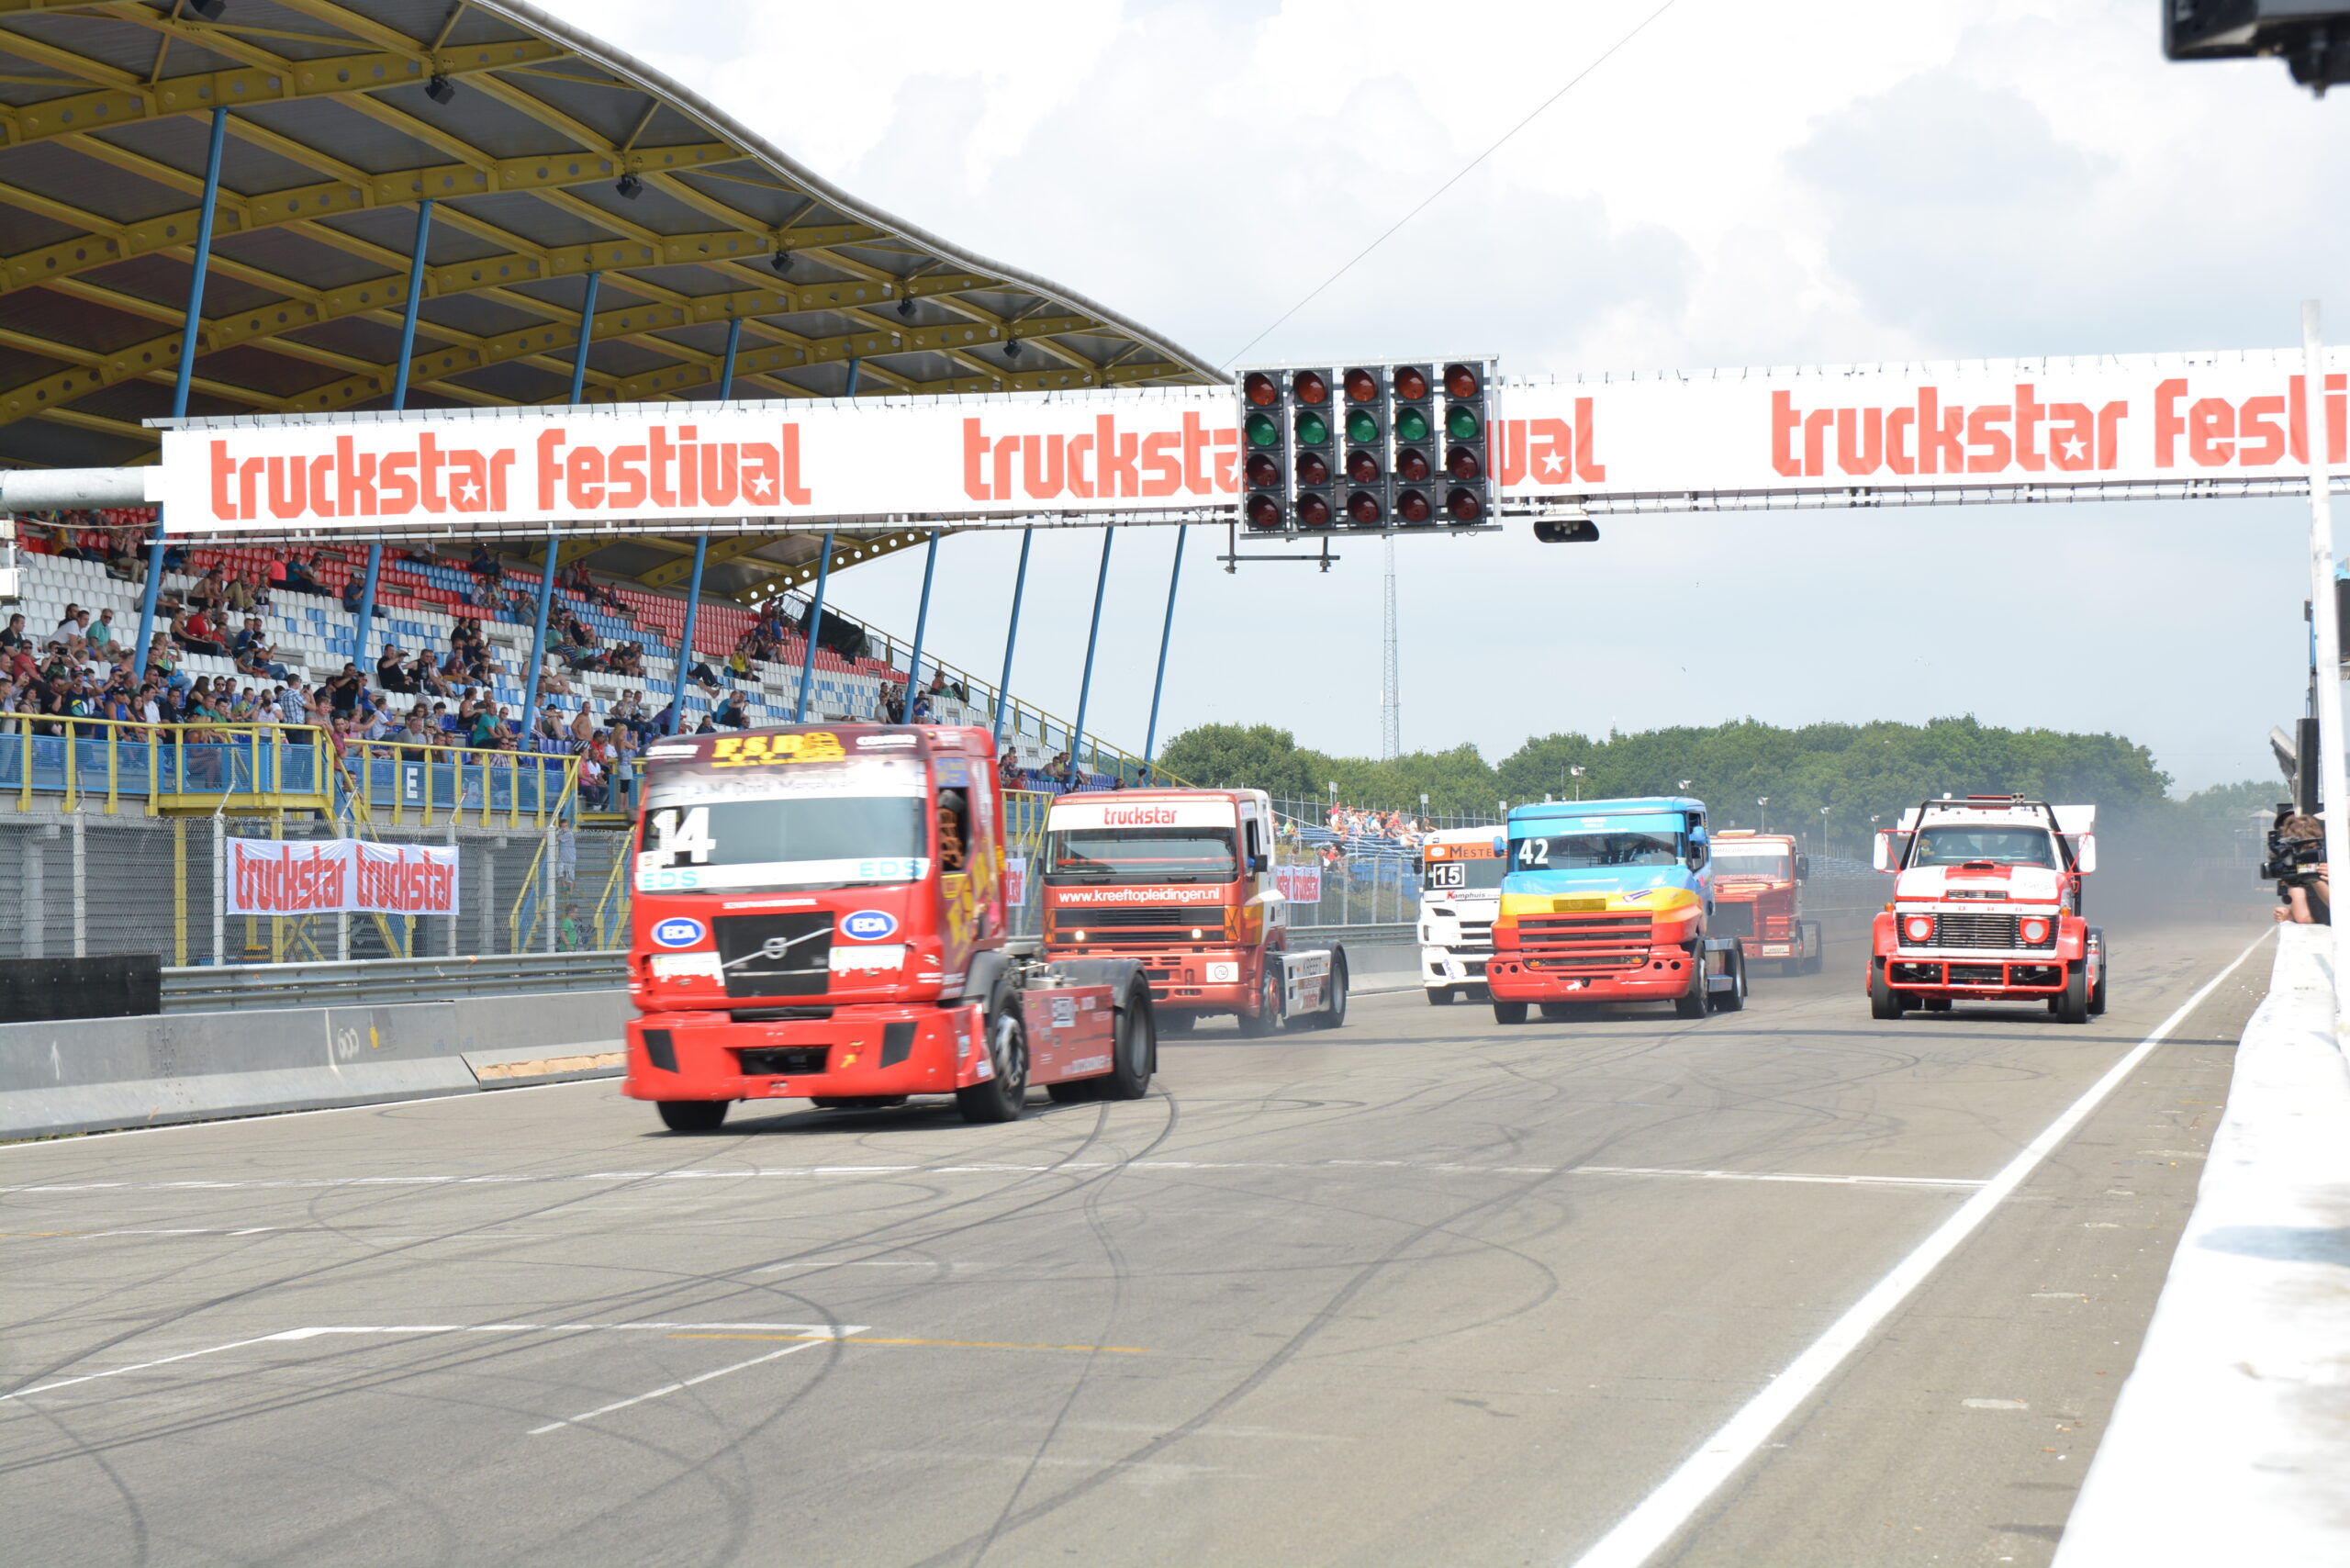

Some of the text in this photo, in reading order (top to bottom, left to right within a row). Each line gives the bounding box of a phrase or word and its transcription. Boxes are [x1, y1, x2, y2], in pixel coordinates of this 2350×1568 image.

[1773, 384, 2128, 476] truckstar
[964, 410, 1246, 500] trucksta
[211, 432, 515, 520] truckstar
[407, 767, 418, 799] E
[1104, 806, 1177, 825] truckstar
[652, 807, 716, 865] 14
[1449, 845, 1507, 857] MESTE
[1519, 839, 1549, 865] 42
[235, 843, 346, 911] truckstar
[356, 845, 453, 911] truckstar
[644, 871, 698, 889] EDS
[860, 859, 923, 878] EDS
[1437, 866, 1460, 885] 15
[1058, 887, 1220, 902] www.kreeftopleidingen.nl
[1446, 890, 1485, 901] Kamphuis
